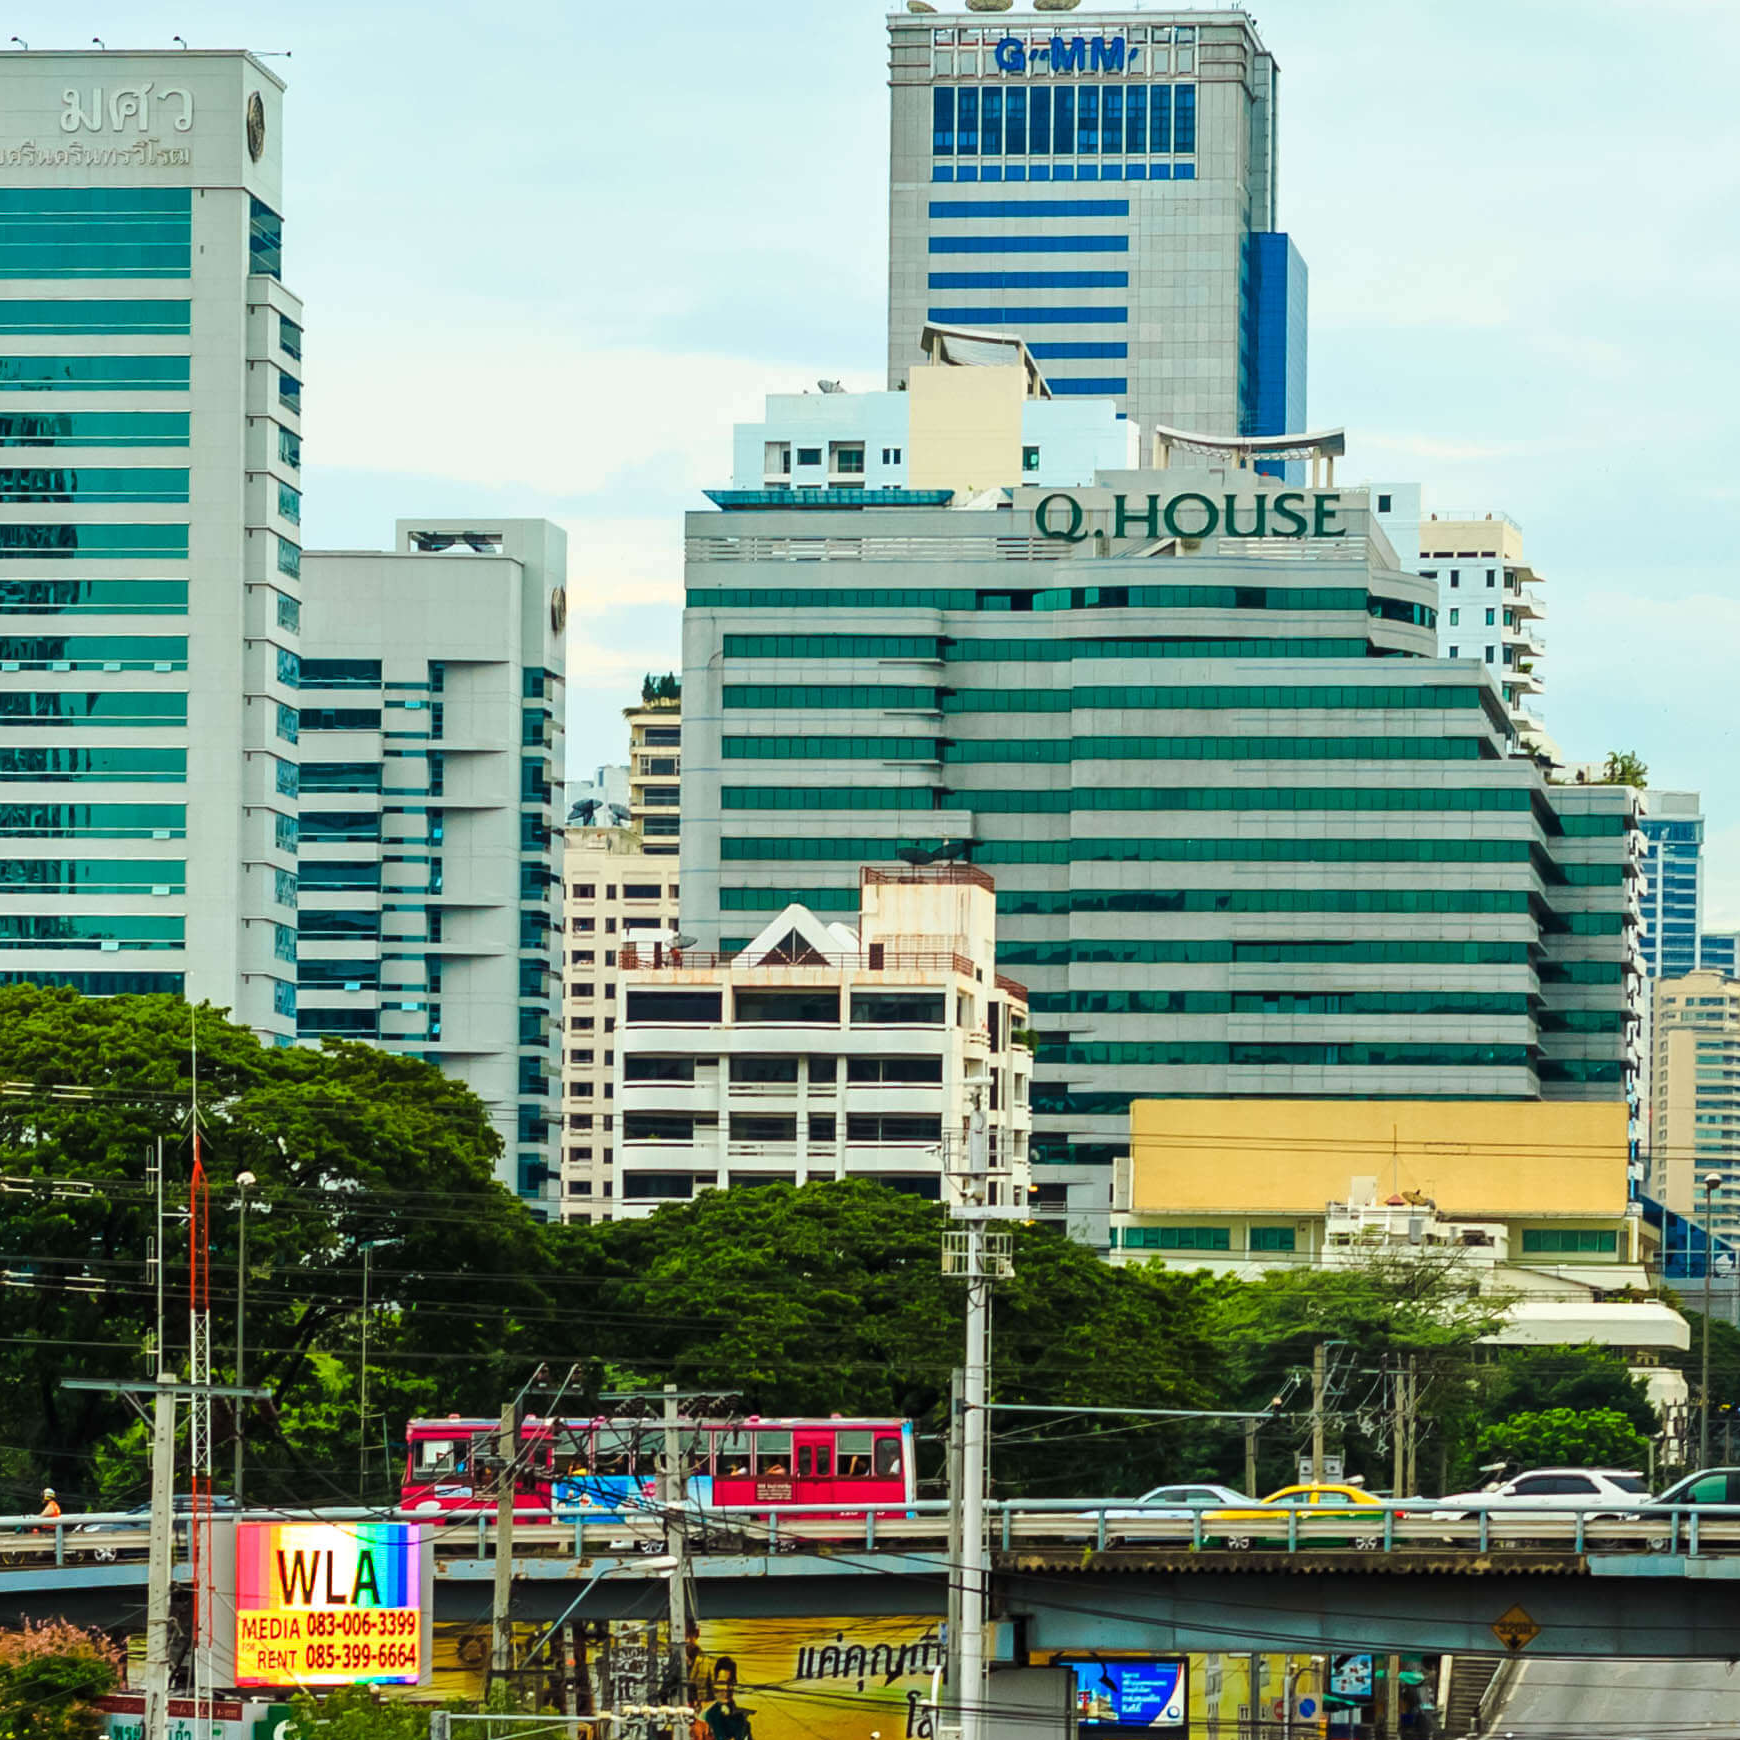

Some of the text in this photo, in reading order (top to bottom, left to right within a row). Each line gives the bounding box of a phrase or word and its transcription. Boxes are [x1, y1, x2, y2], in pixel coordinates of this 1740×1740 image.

[61, 83, 195, 134] มศว
[276, 1549, 383, 1605] WLA
[241, 1611, 415, 1640] MEDIA 083-006-3399
[257, 1643, 416, 1669] RENT 085-399-6664
